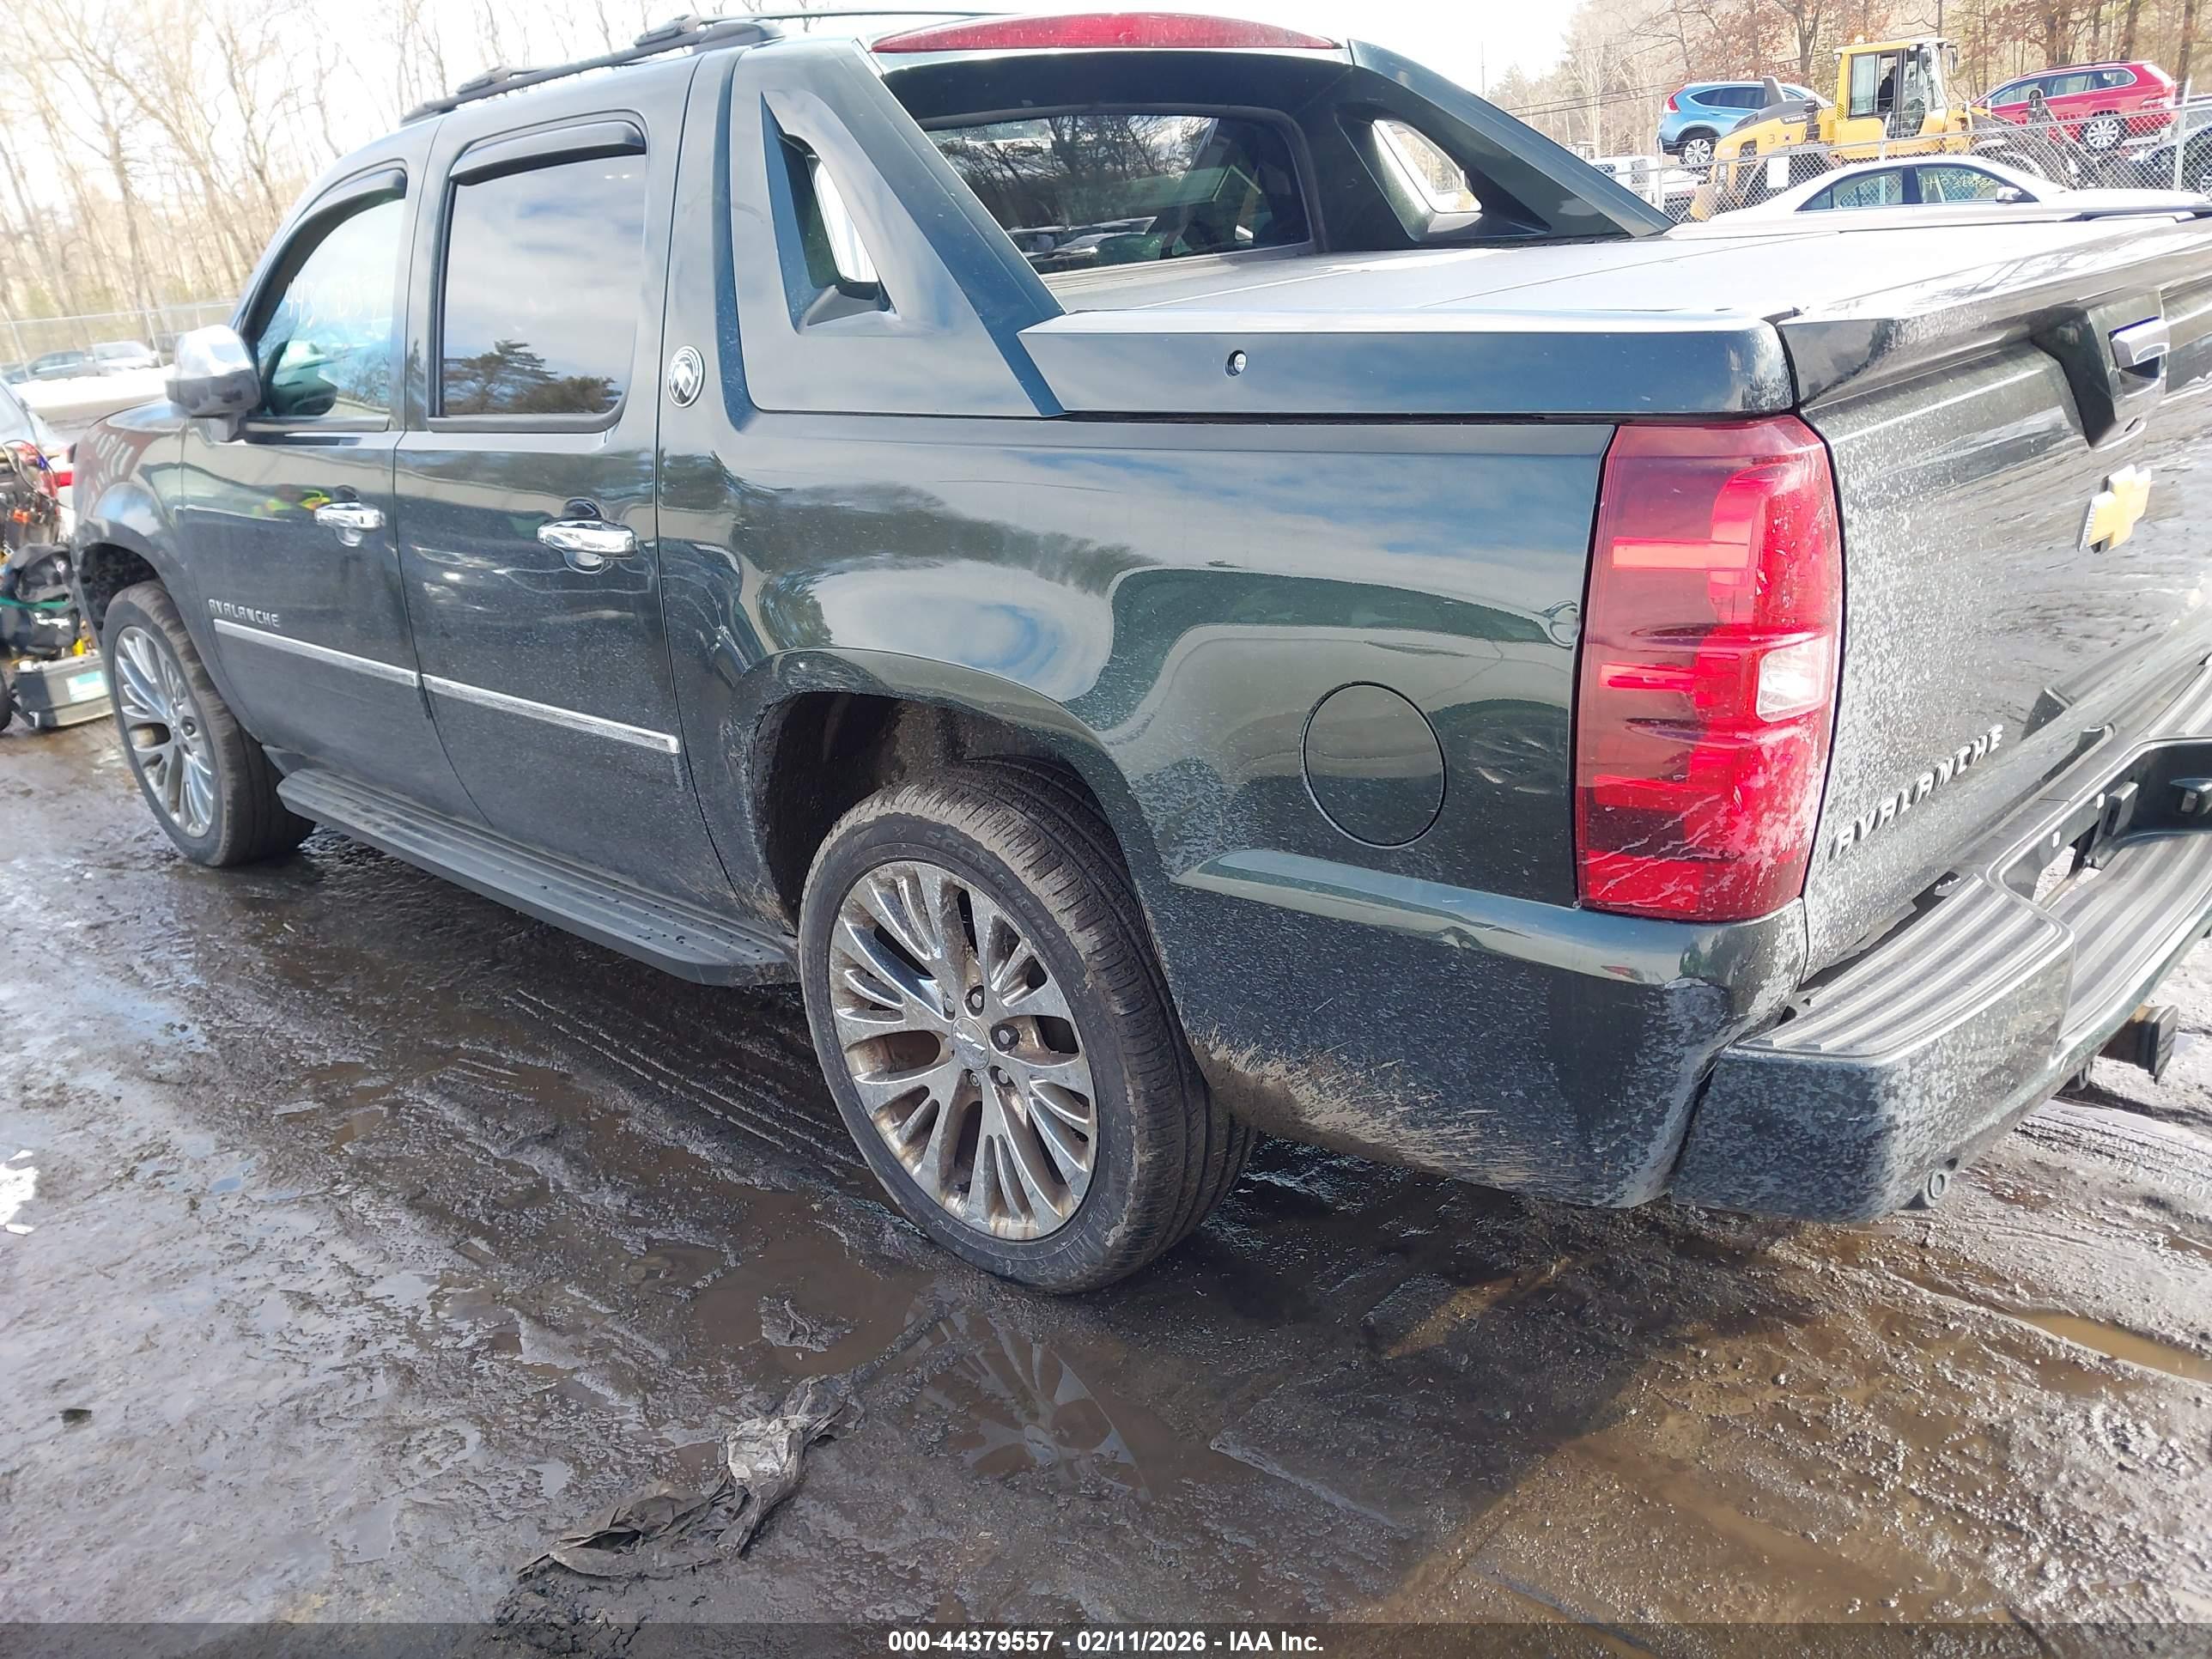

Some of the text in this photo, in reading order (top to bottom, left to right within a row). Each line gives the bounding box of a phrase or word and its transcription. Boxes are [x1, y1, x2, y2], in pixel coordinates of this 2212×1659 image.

[1784, 114, 1808, 124] VOLV
[1768, 134, 1776, 144] 3
[208, 598, 281, 628] AVALANCHE
[1829, 724, 2003, 860] AVALANCHE
